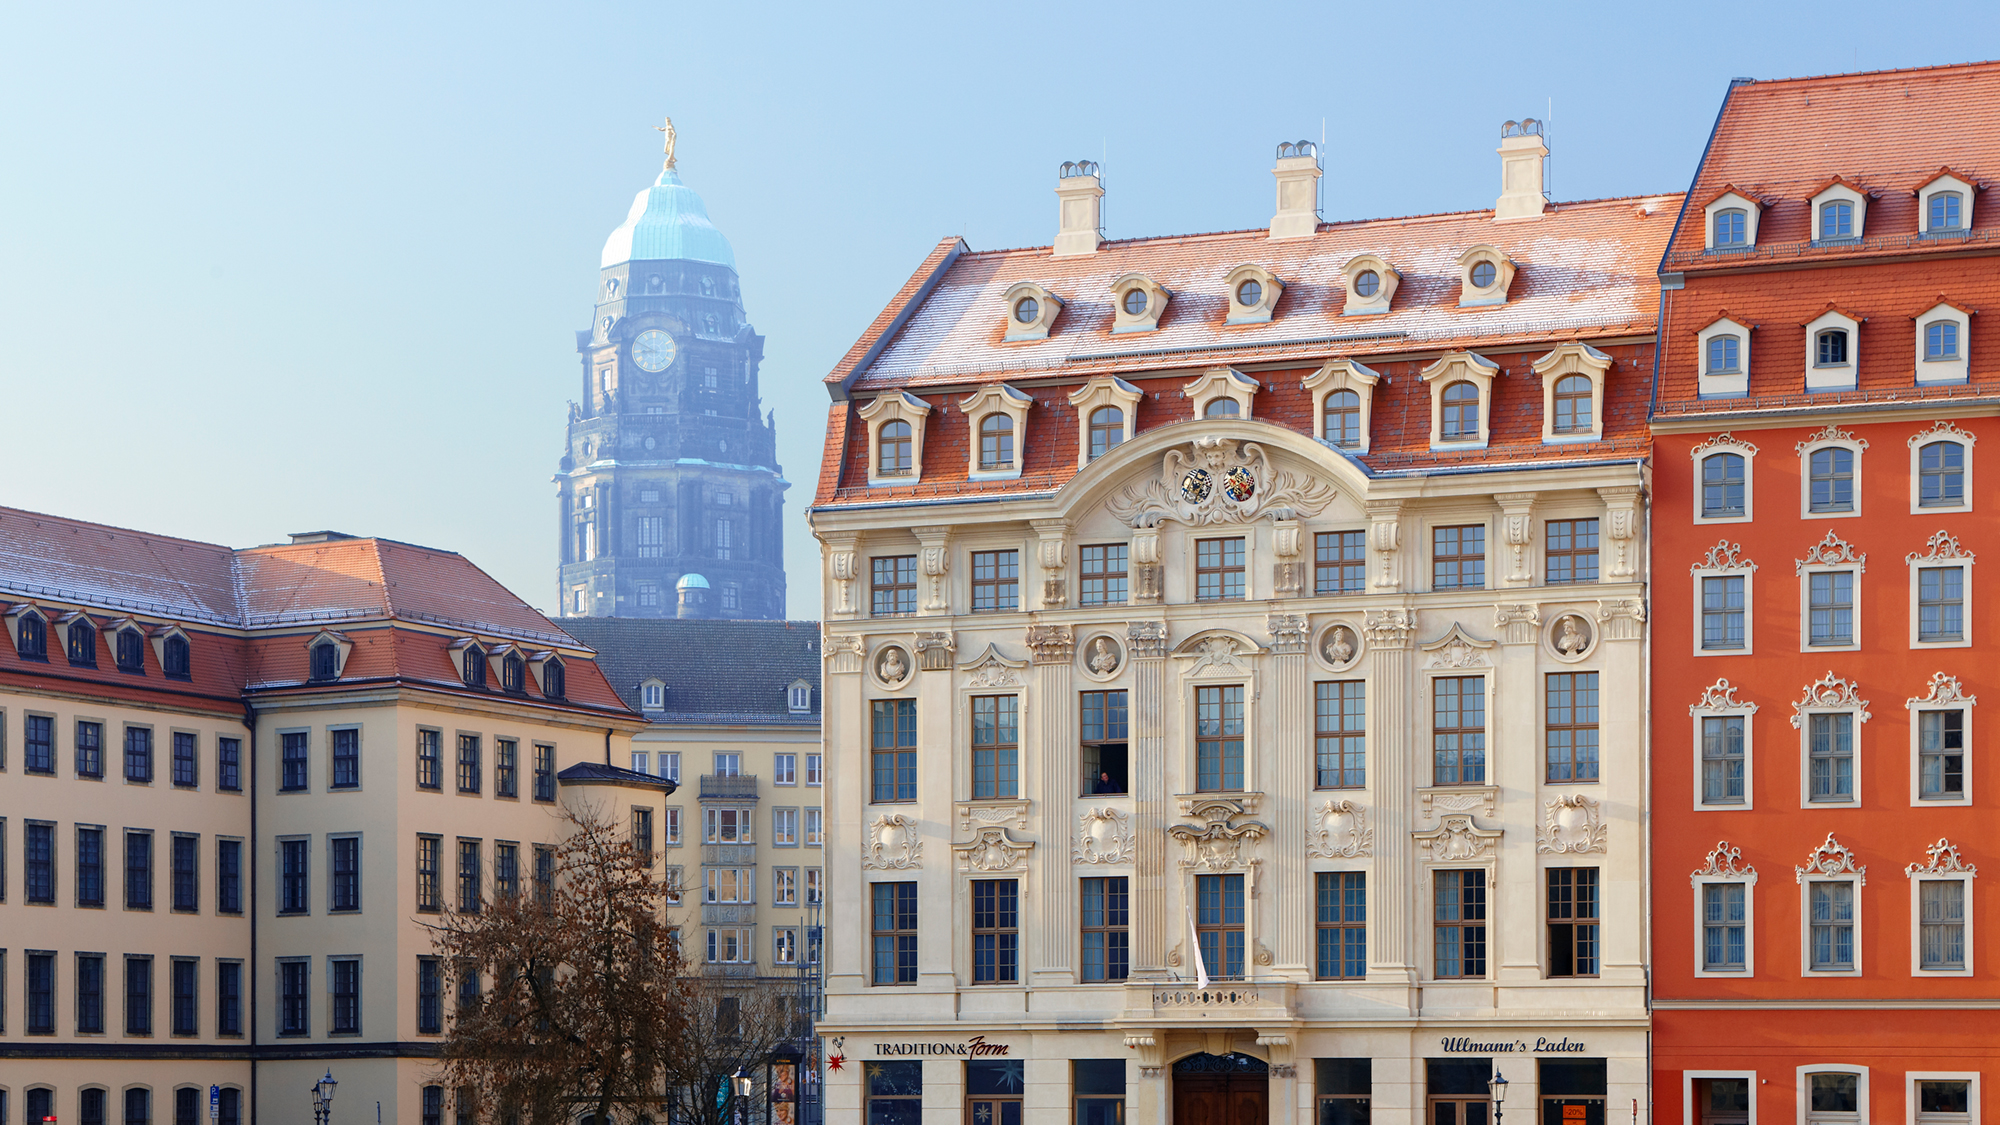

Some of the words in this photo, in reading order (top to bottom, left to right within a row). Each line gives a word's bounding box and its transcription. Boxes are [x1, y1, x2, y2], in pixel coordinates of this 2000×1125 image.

[967, 1035, 1009, 1060] Form
[1441, 1036, 1526, 1053] Ullmann's
[1533, 1036, 1586, 1053] Laden
[1566, 1108, 1584, 1116] -20%
